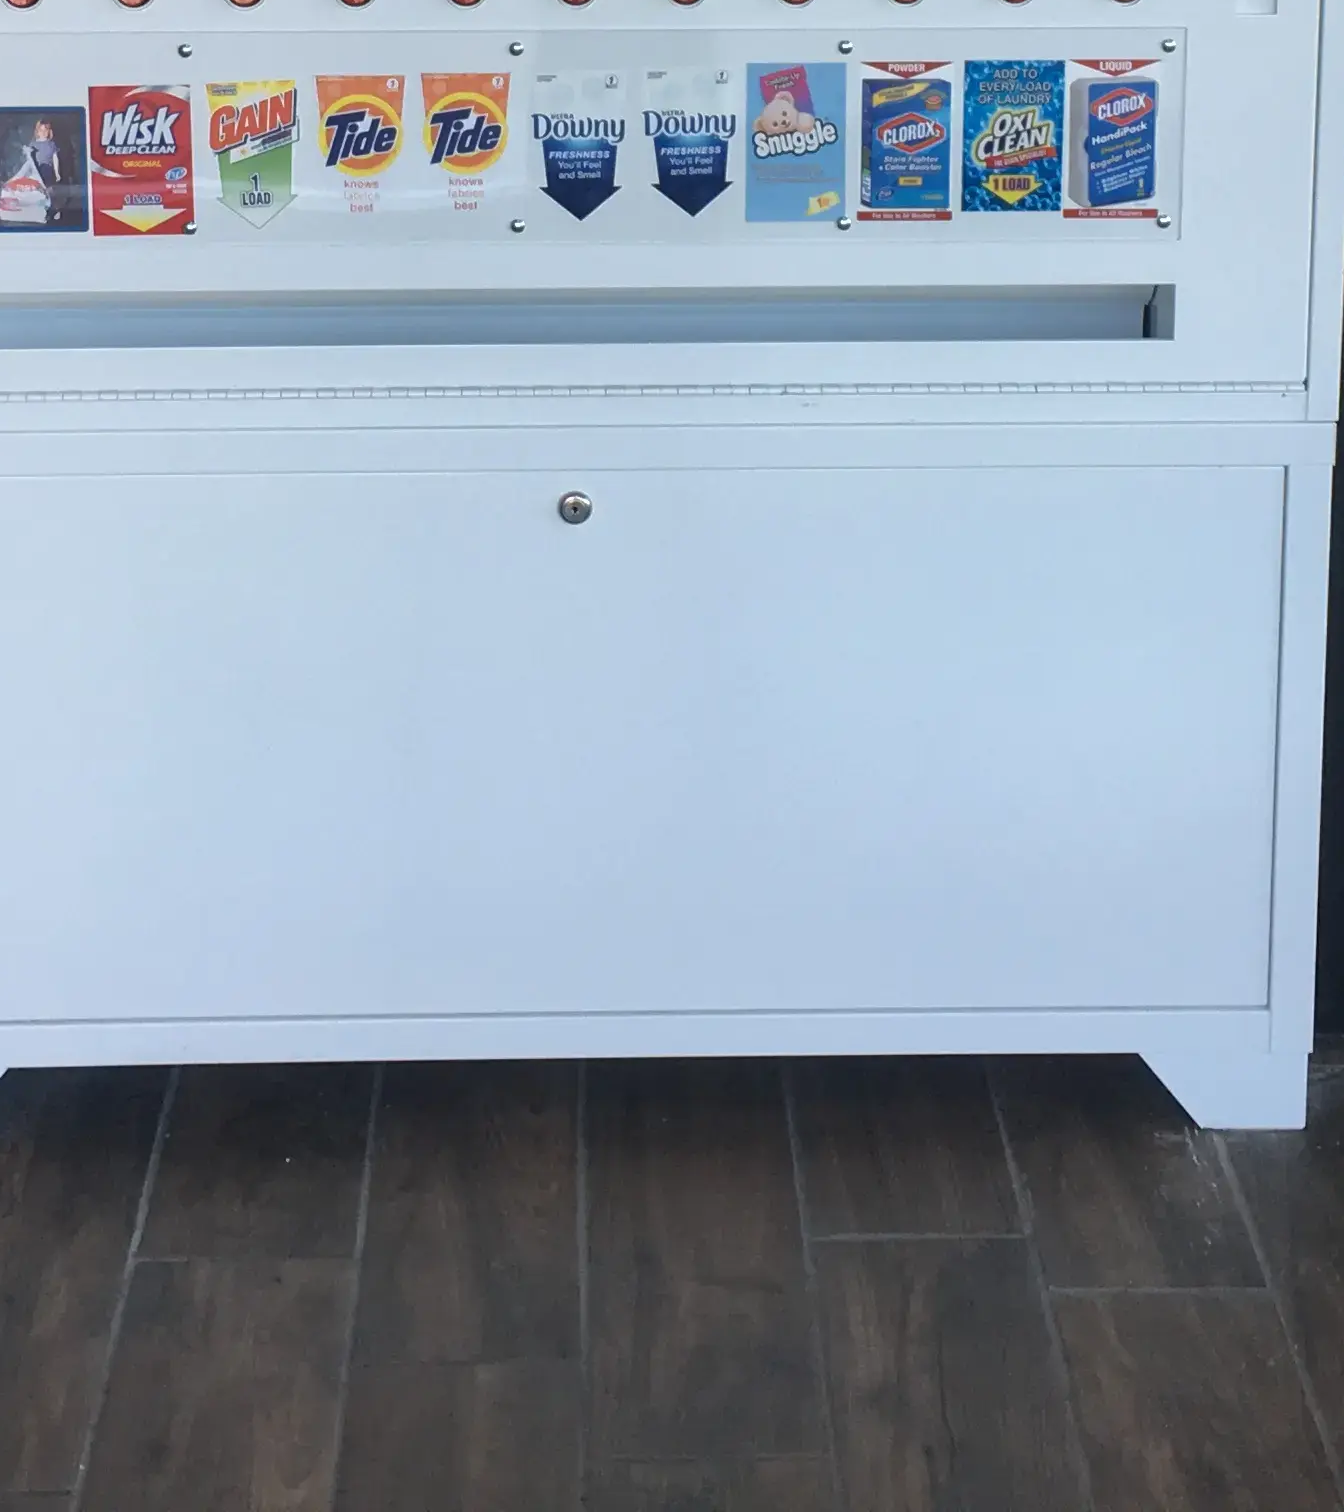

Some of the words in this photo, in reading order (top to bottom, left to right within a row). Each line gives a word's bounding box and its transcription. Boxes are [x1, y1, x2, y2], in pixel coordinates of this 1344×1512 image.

[888, 63, 925, 72] POWDER
[1099, 61, 1133, 72] LIQUID
[993, 69, 1018, 79] ADD
[1021, 68, 1038, 79] TO
[979, 81, 1017, 92] EVERY
[1019, 81, 1052, 91] LOAD
[978, 95, 994, 104] OF
[997, 94, 1052, 104] LAUNDRY
[1097, 92, 1147, 121] CLOROX
[101, 103, 180, 146] Wisk
[209, 88, 297, 153] GAIN
[642, 110, 736, 139] Downy
[993, 111, 1035, 137] OXI
[530, 113, 626, 144] Downy
[1091, 121, 1148, 146] HandiPack
[324, 108, 398, 167] Tide
[430, 107, 502, 165] Tide
[753, 118, 838, 159] Snuggle
[977, 125, 1049, 161] CLEAN
[105, 146, 137, 155] DEEP
[137, 146, 176, 155] CLEAN
[548, 150, 610, 159] FRESHNESS
[660, 146, 722, 155] FRESHNESS
[558, 171, 576, 179] and
[577, 170, 602, 179] Smell
[670, 167, 687, 175] and
[688, 166, 713, 175] Smell
[250, 173, 259, 192] 1
[344, 179, 379, 189] knows
[449, 177, 484, 186] knows
[993, 178, 999, 191] 1
[1001, 178, 1031, 191] LOAD
[133, 194, 163, 205] LOAD
[242, 191, 272, 206] LOAD
[350, 203, 374, 213] best
[454, 200, 478, 210] best
